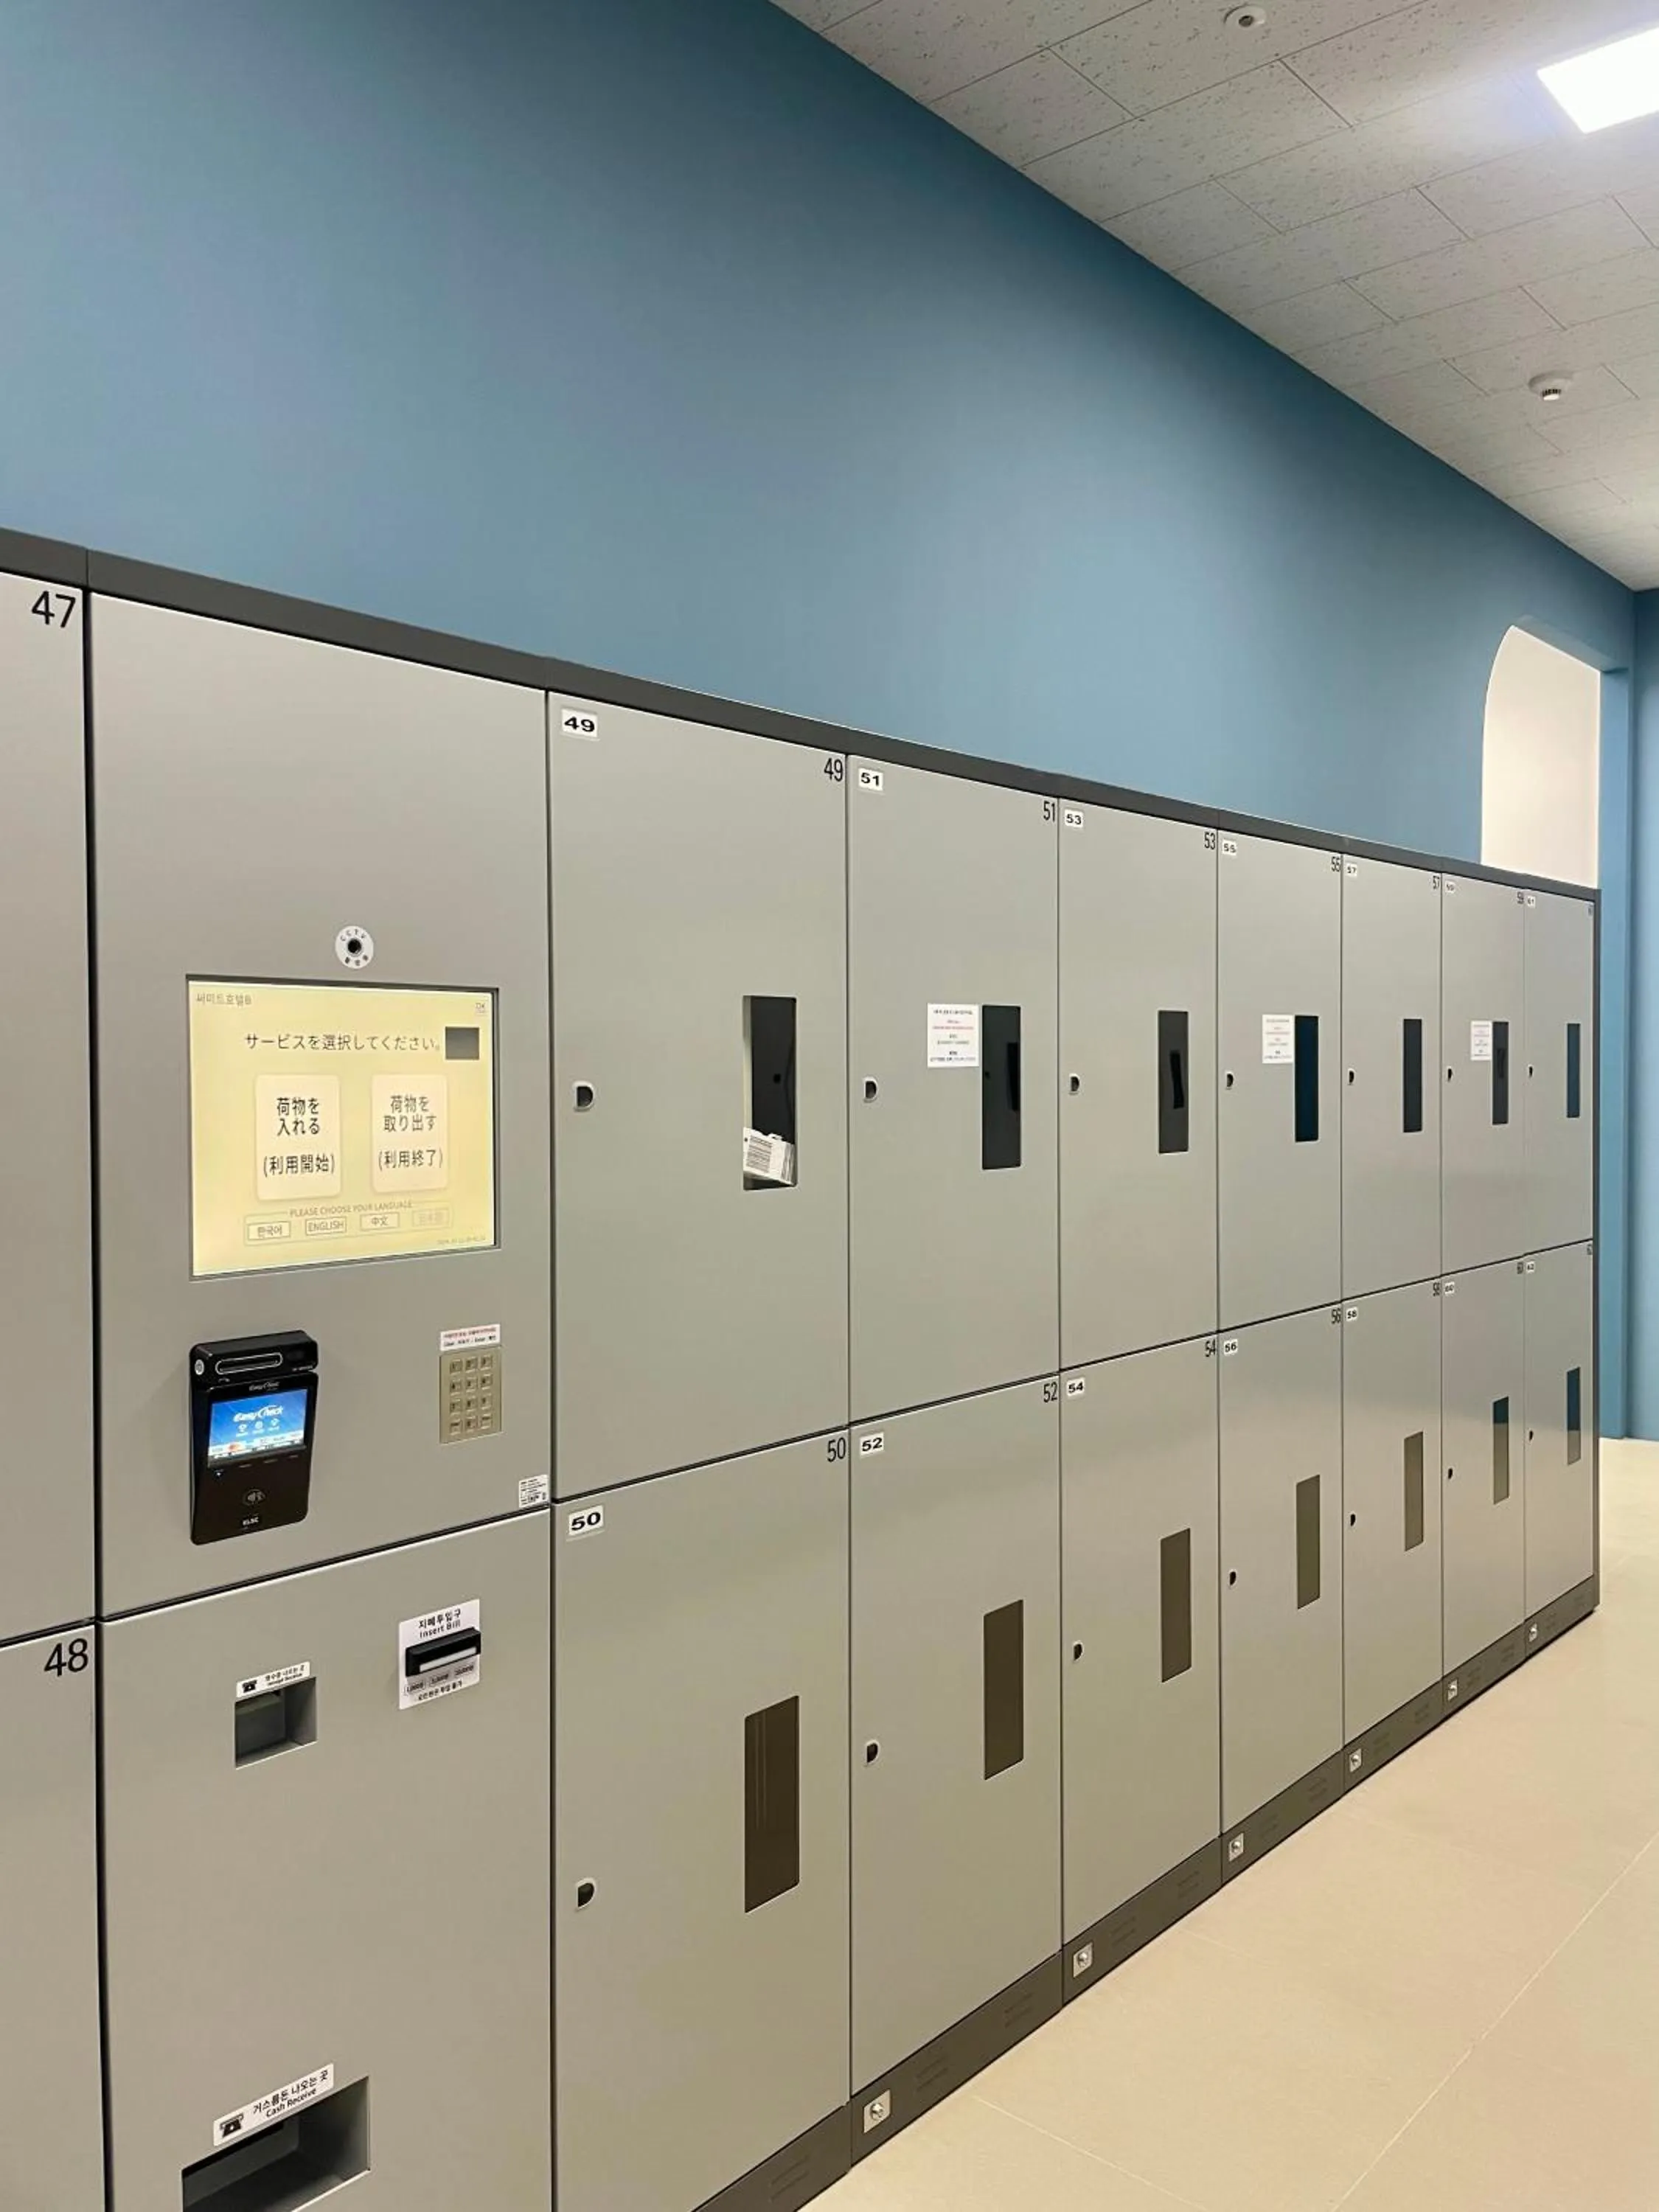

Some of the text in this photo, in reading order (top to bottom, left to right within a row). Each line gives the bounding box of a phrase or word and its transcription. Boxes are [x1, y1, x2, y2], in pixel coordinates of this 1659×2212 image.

[32, 591, 76, 628] 47
[564, 716, 595, 732] 49
[824, 757, 844, 782] 49
[861, 772, 880, 787] 51
[1043, 800, 1055, 822] 51
[1066, 813, 1082, 824] 53
[1204, 832, 1215, 849] 53
[1224, 843, 1237, 853] 55
[244, 1032, 441, 1051] サービスを選択してください。
[276, 1097, 319, 1116] 荷物を
[391, 1094, 430, 1113] 荷物を
[276, 1117, 320, 1136] 入れる
[383, 1114, 437, 1133] 取り出す
[264, 1153, 335, 1178] (利用開始)
[378, 1147, 443, 1171] (利用終了)
[290, 1206, 318, 1217] PLEASE
[319, 1204, 352, 1215] CHOOSE
[352, 1202, 372, 1213] YOUR
[307, 1220, 344, 1232] ENGLISH
[371, 1215, 389, 1226] 中文
[1347, 1309, 1357, 1318] 58
[1205, 1339, 1216, 1357] 54
[1225, 1342, 1237, 1352] 56
[1043, 1381, 1058, 1403] 52
[1068, 1381, 1083, 1394] 54
[827, 1437, 846, 1463] 50
[862, 1437, 883, 1452] 52
[571, 1512, 601, 1531] 50
[420, 1618, 461, 1638] Insert Bill
[44, 1638, 88, 1677] 48
[253, 2090, 288, 2114] 거스름돈
[291, 2077, 318, 2094] 나오는
[266, 2088, 316, 2118] Cash Receive
